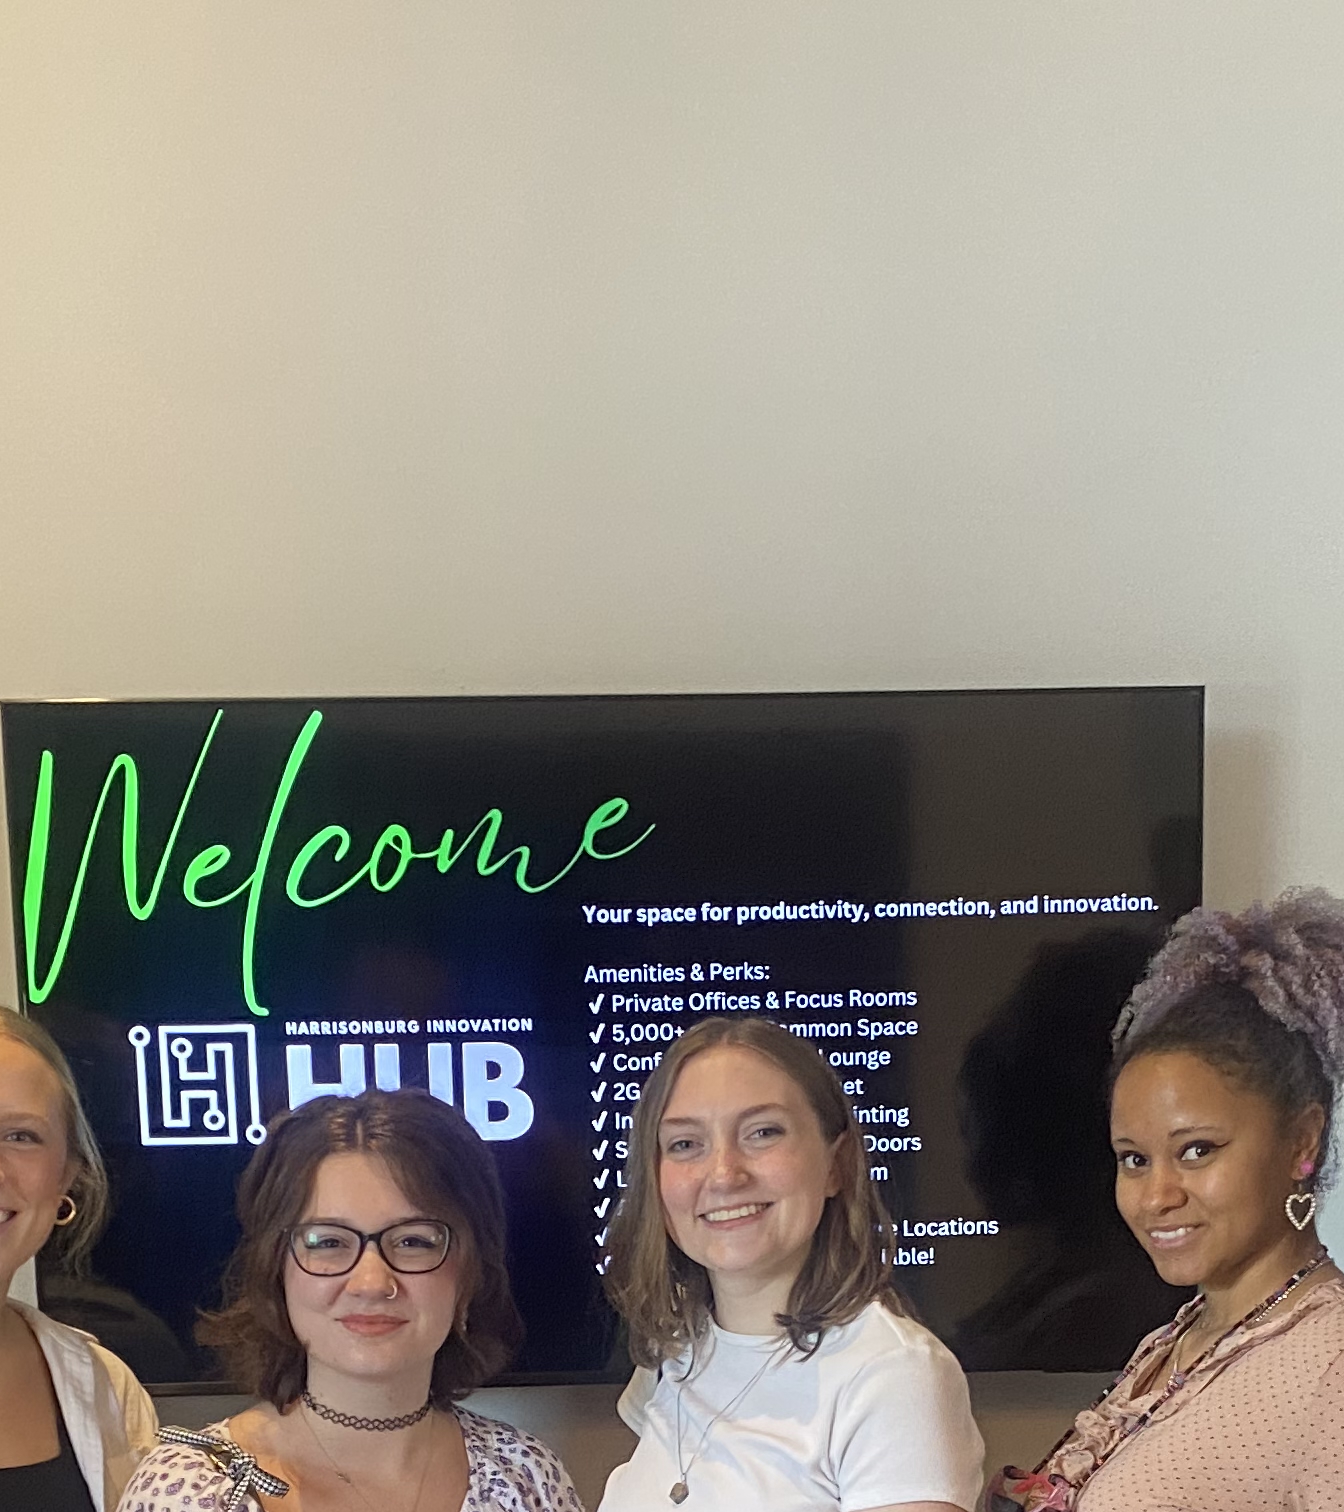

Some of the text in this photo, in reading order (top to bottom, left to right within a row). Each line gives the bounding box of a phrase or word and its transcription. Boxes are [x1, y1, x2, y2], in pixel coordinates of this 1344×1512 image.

[23, 709, 656, 1017] Welcome
[582, 892, 1160, 926] Your space for productivity, connection, and innovation.
[583, 961, 771, 983] Amenities & Perks:
[611, 989, 918, 1013] Private Offices & Focus Rooms
[285, 1017, 533, 1036] HARRISONBURG INNOVATION
[612, 1018, 919, 1045] 5,000+ mmon Space
[852, 1104, 910, 1128] inting
[903, 1217, 1000, 1238] Locations
